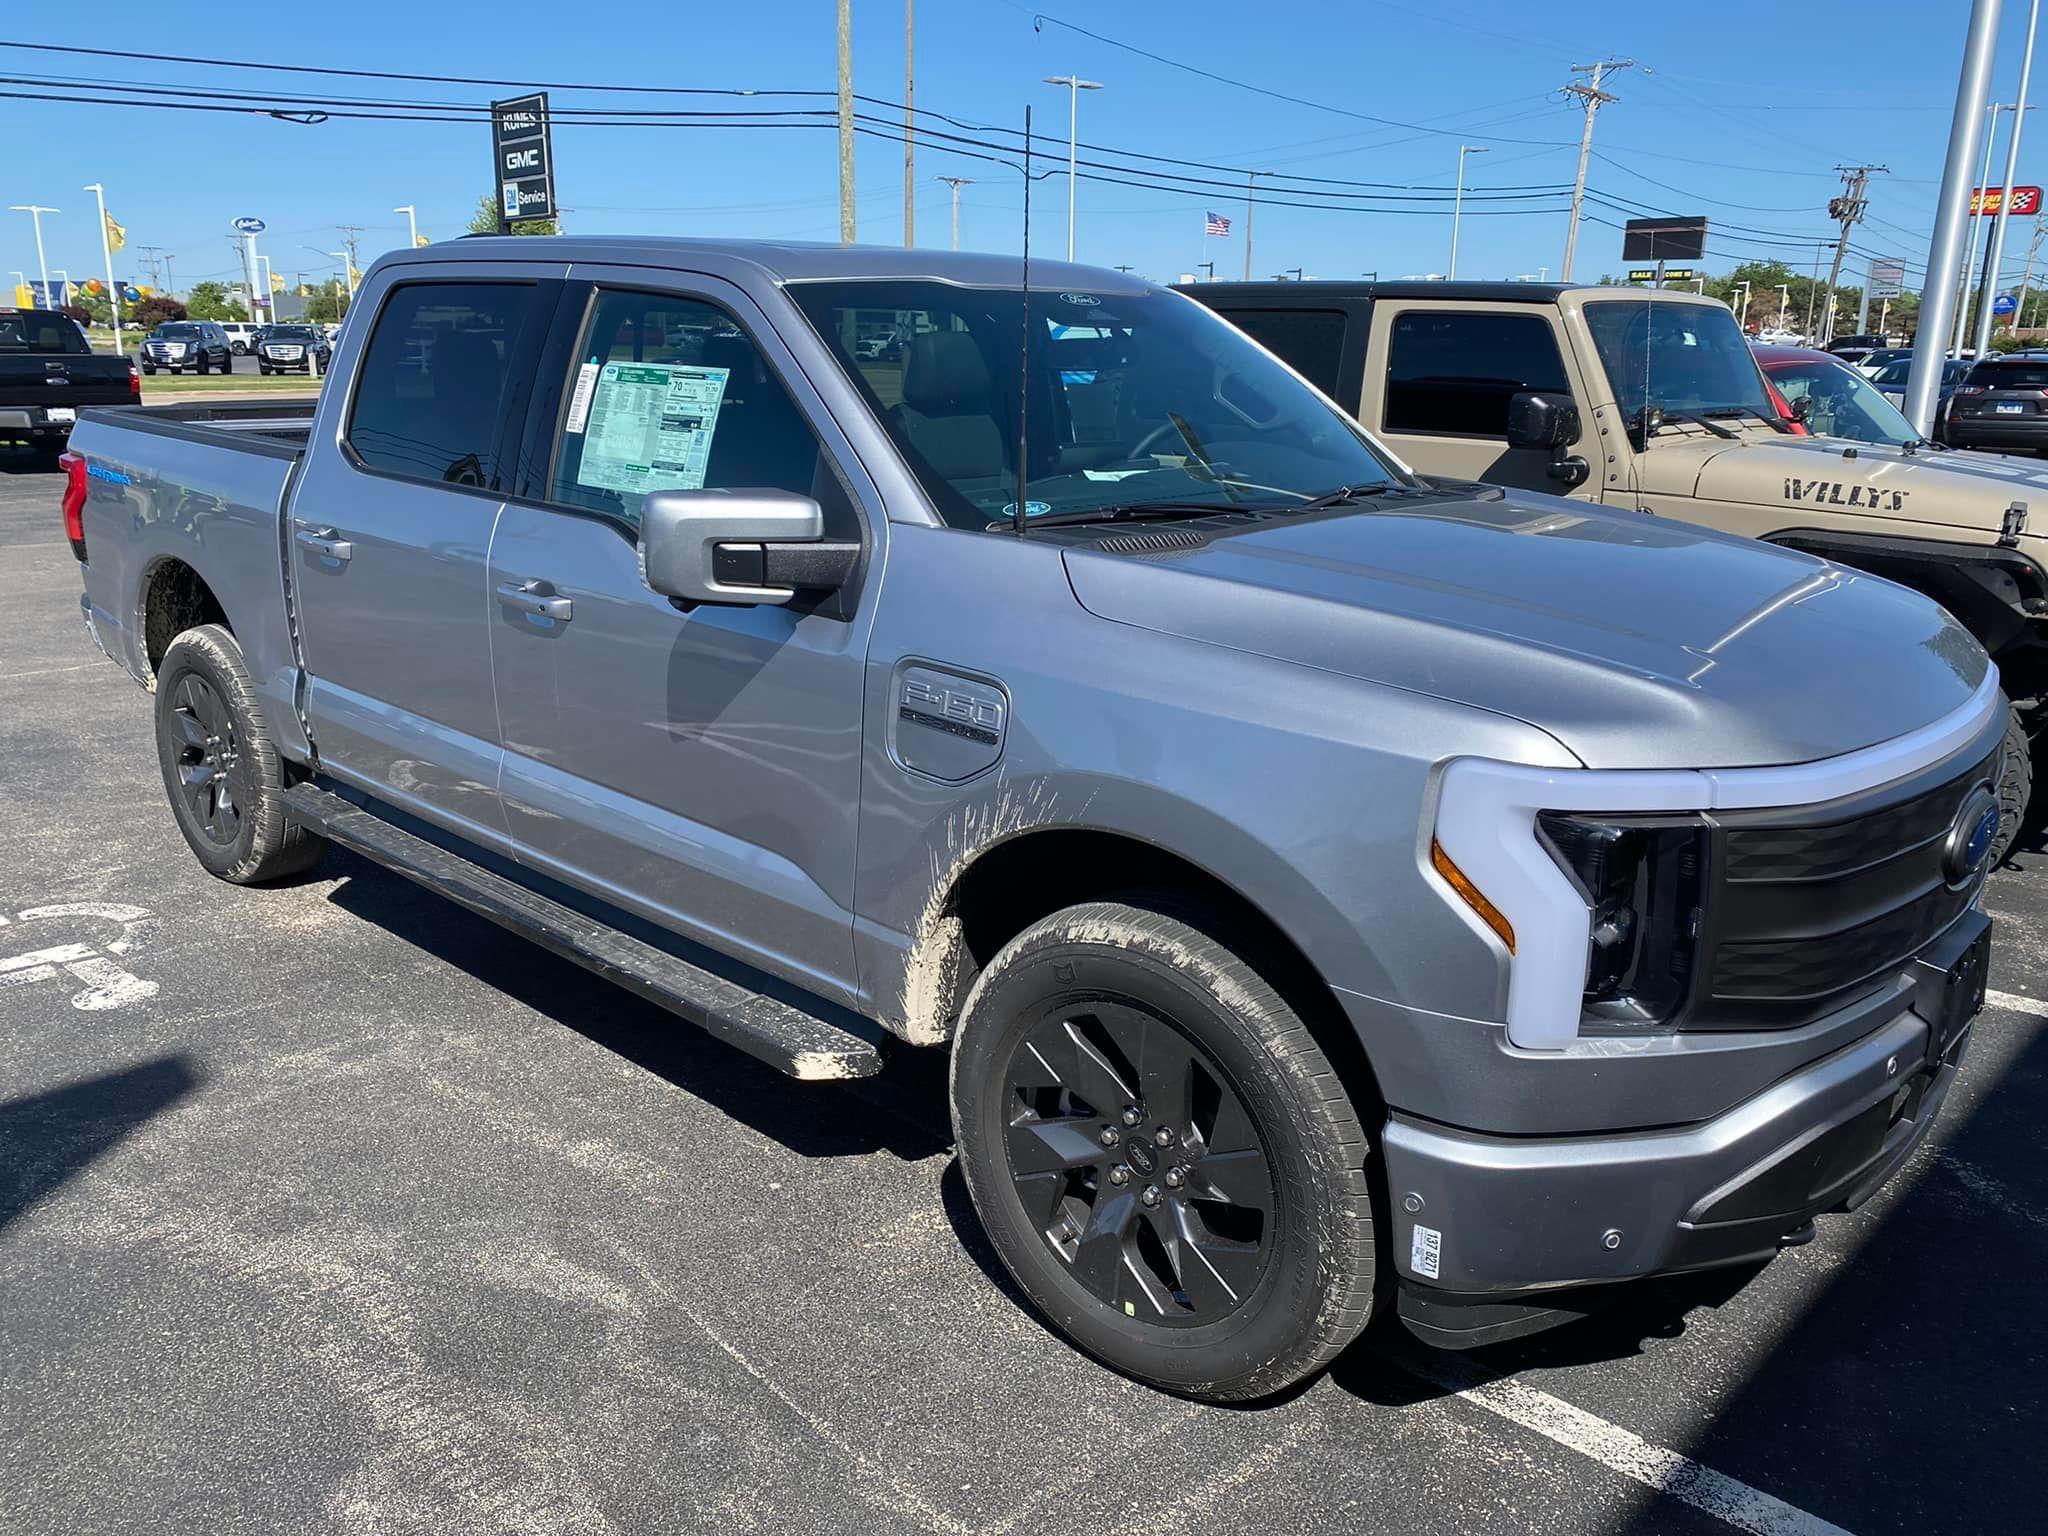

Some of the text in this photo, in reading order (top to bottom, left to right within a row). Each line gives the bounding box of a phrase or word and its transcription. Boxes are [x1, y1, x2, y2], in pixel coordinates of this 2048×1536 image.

[506, 148, 539, 170] GMC
[518, 190, 546, 205] Service
[673, 381, 683, 392] 70
[1783, 477, 1911, 511] WILLYS
[901, 680, 1003, 733] F-150
[1425, 1233, 1439, 1273] 137 8271
